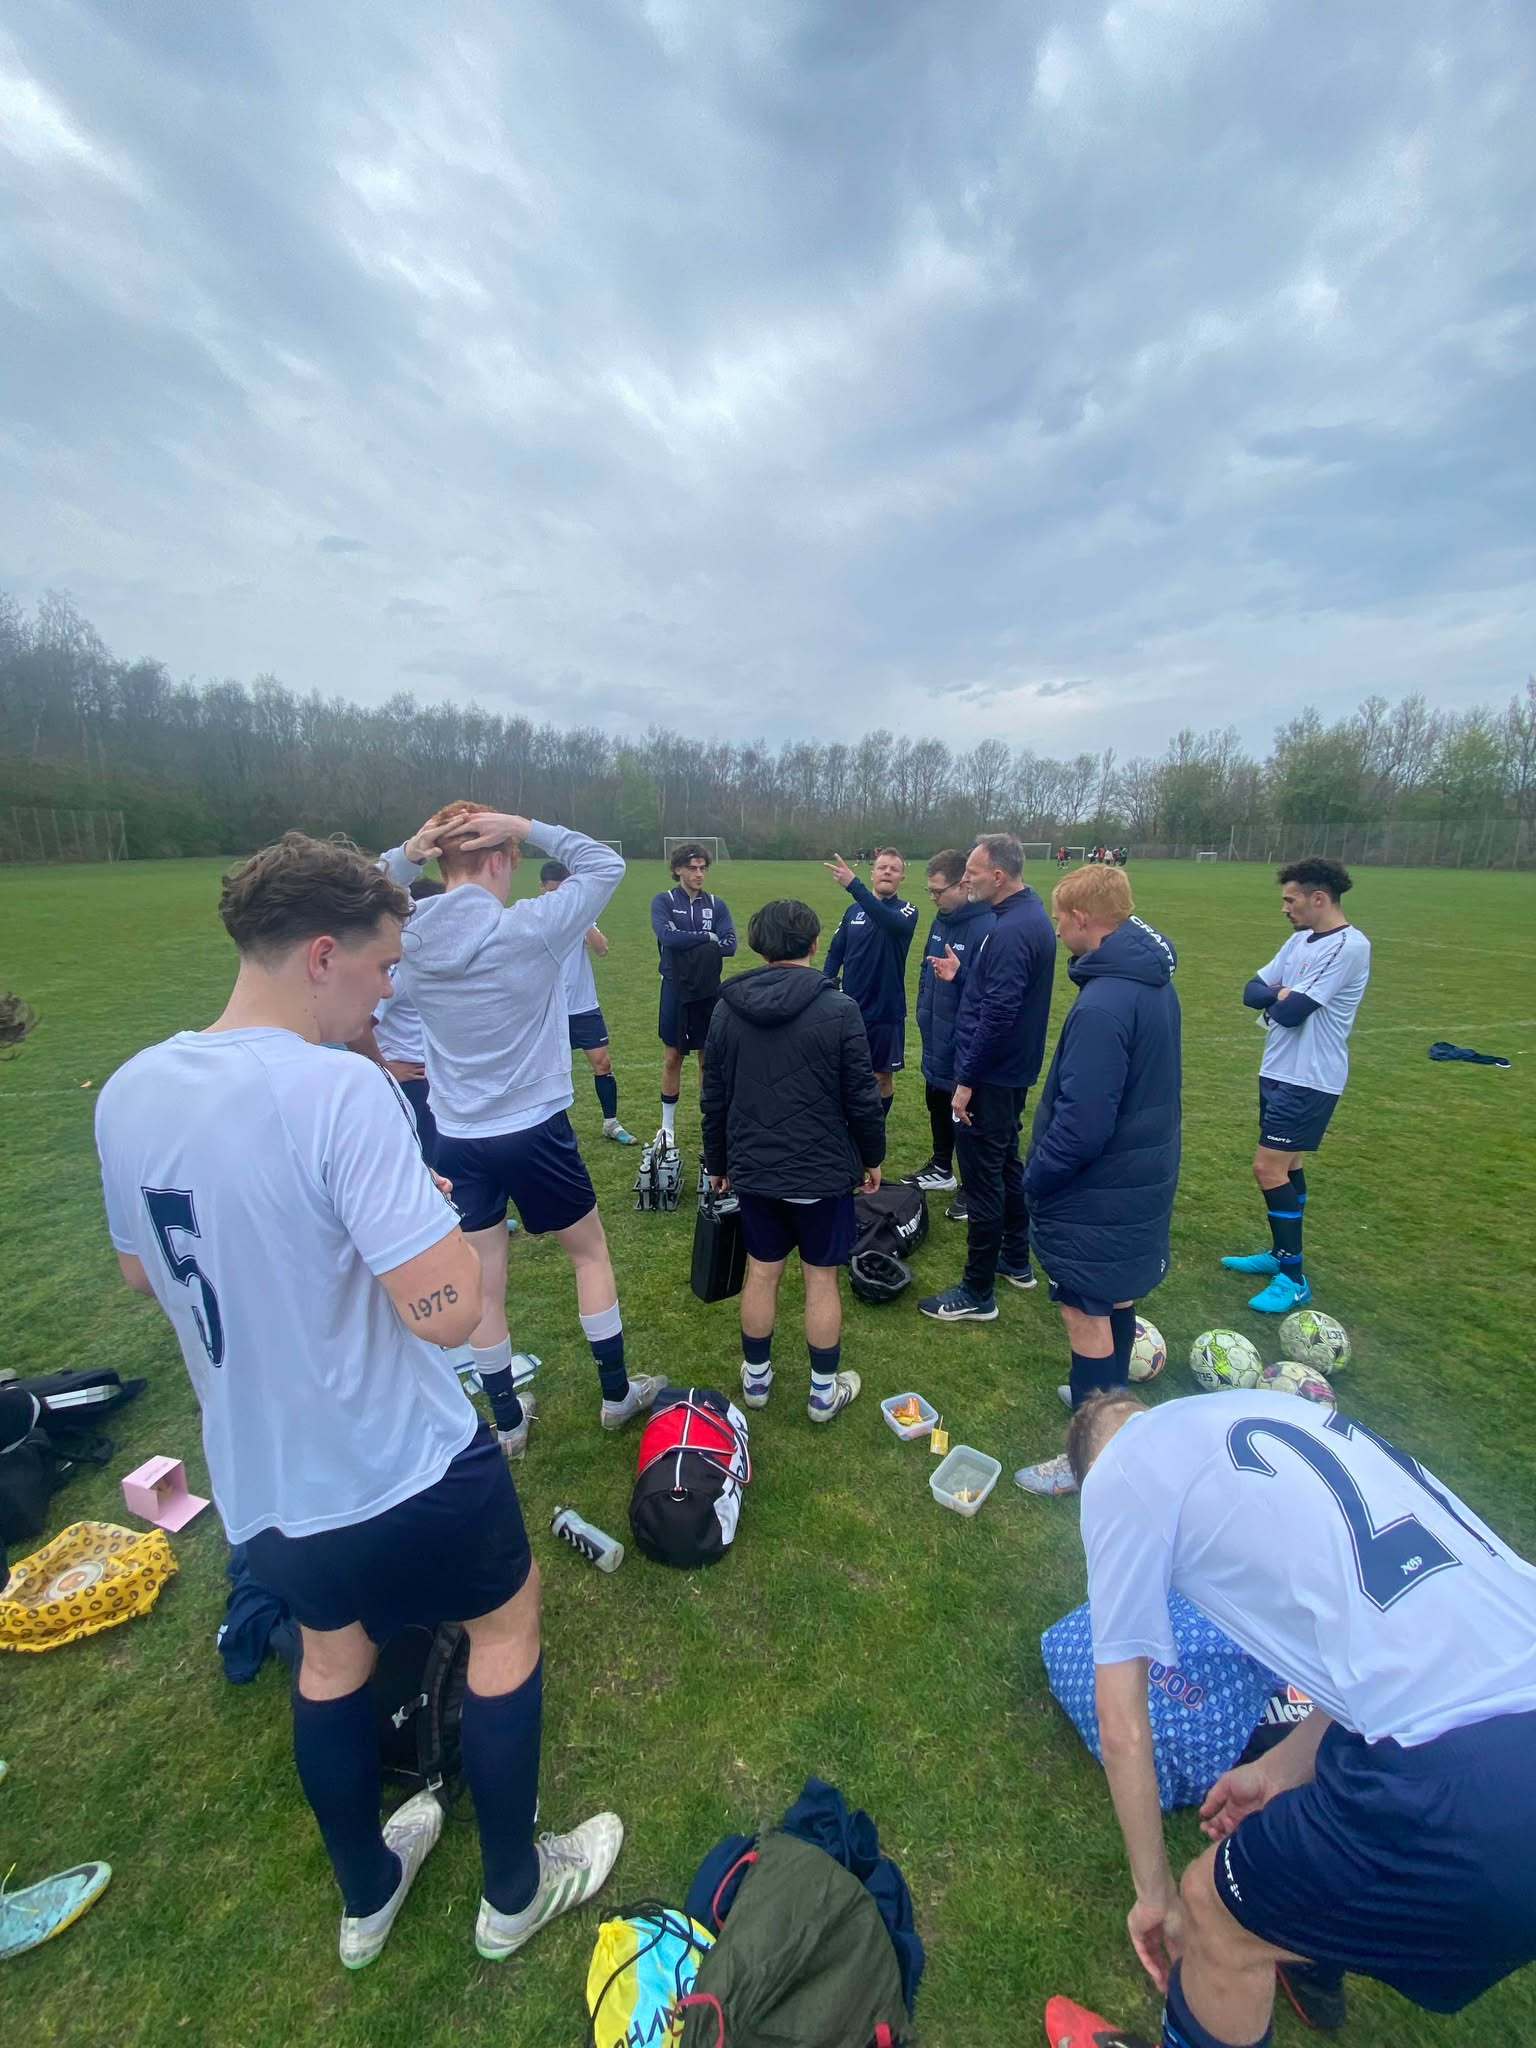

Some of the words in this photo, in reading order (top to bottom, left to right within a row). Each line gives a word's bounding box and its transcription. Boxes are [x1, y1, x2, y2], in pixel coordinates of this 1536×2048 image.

[702, 919, 712, 930] 20
[141, 1186, 225, 1368] 5
[408, 1284, 458, 1321] 1978
